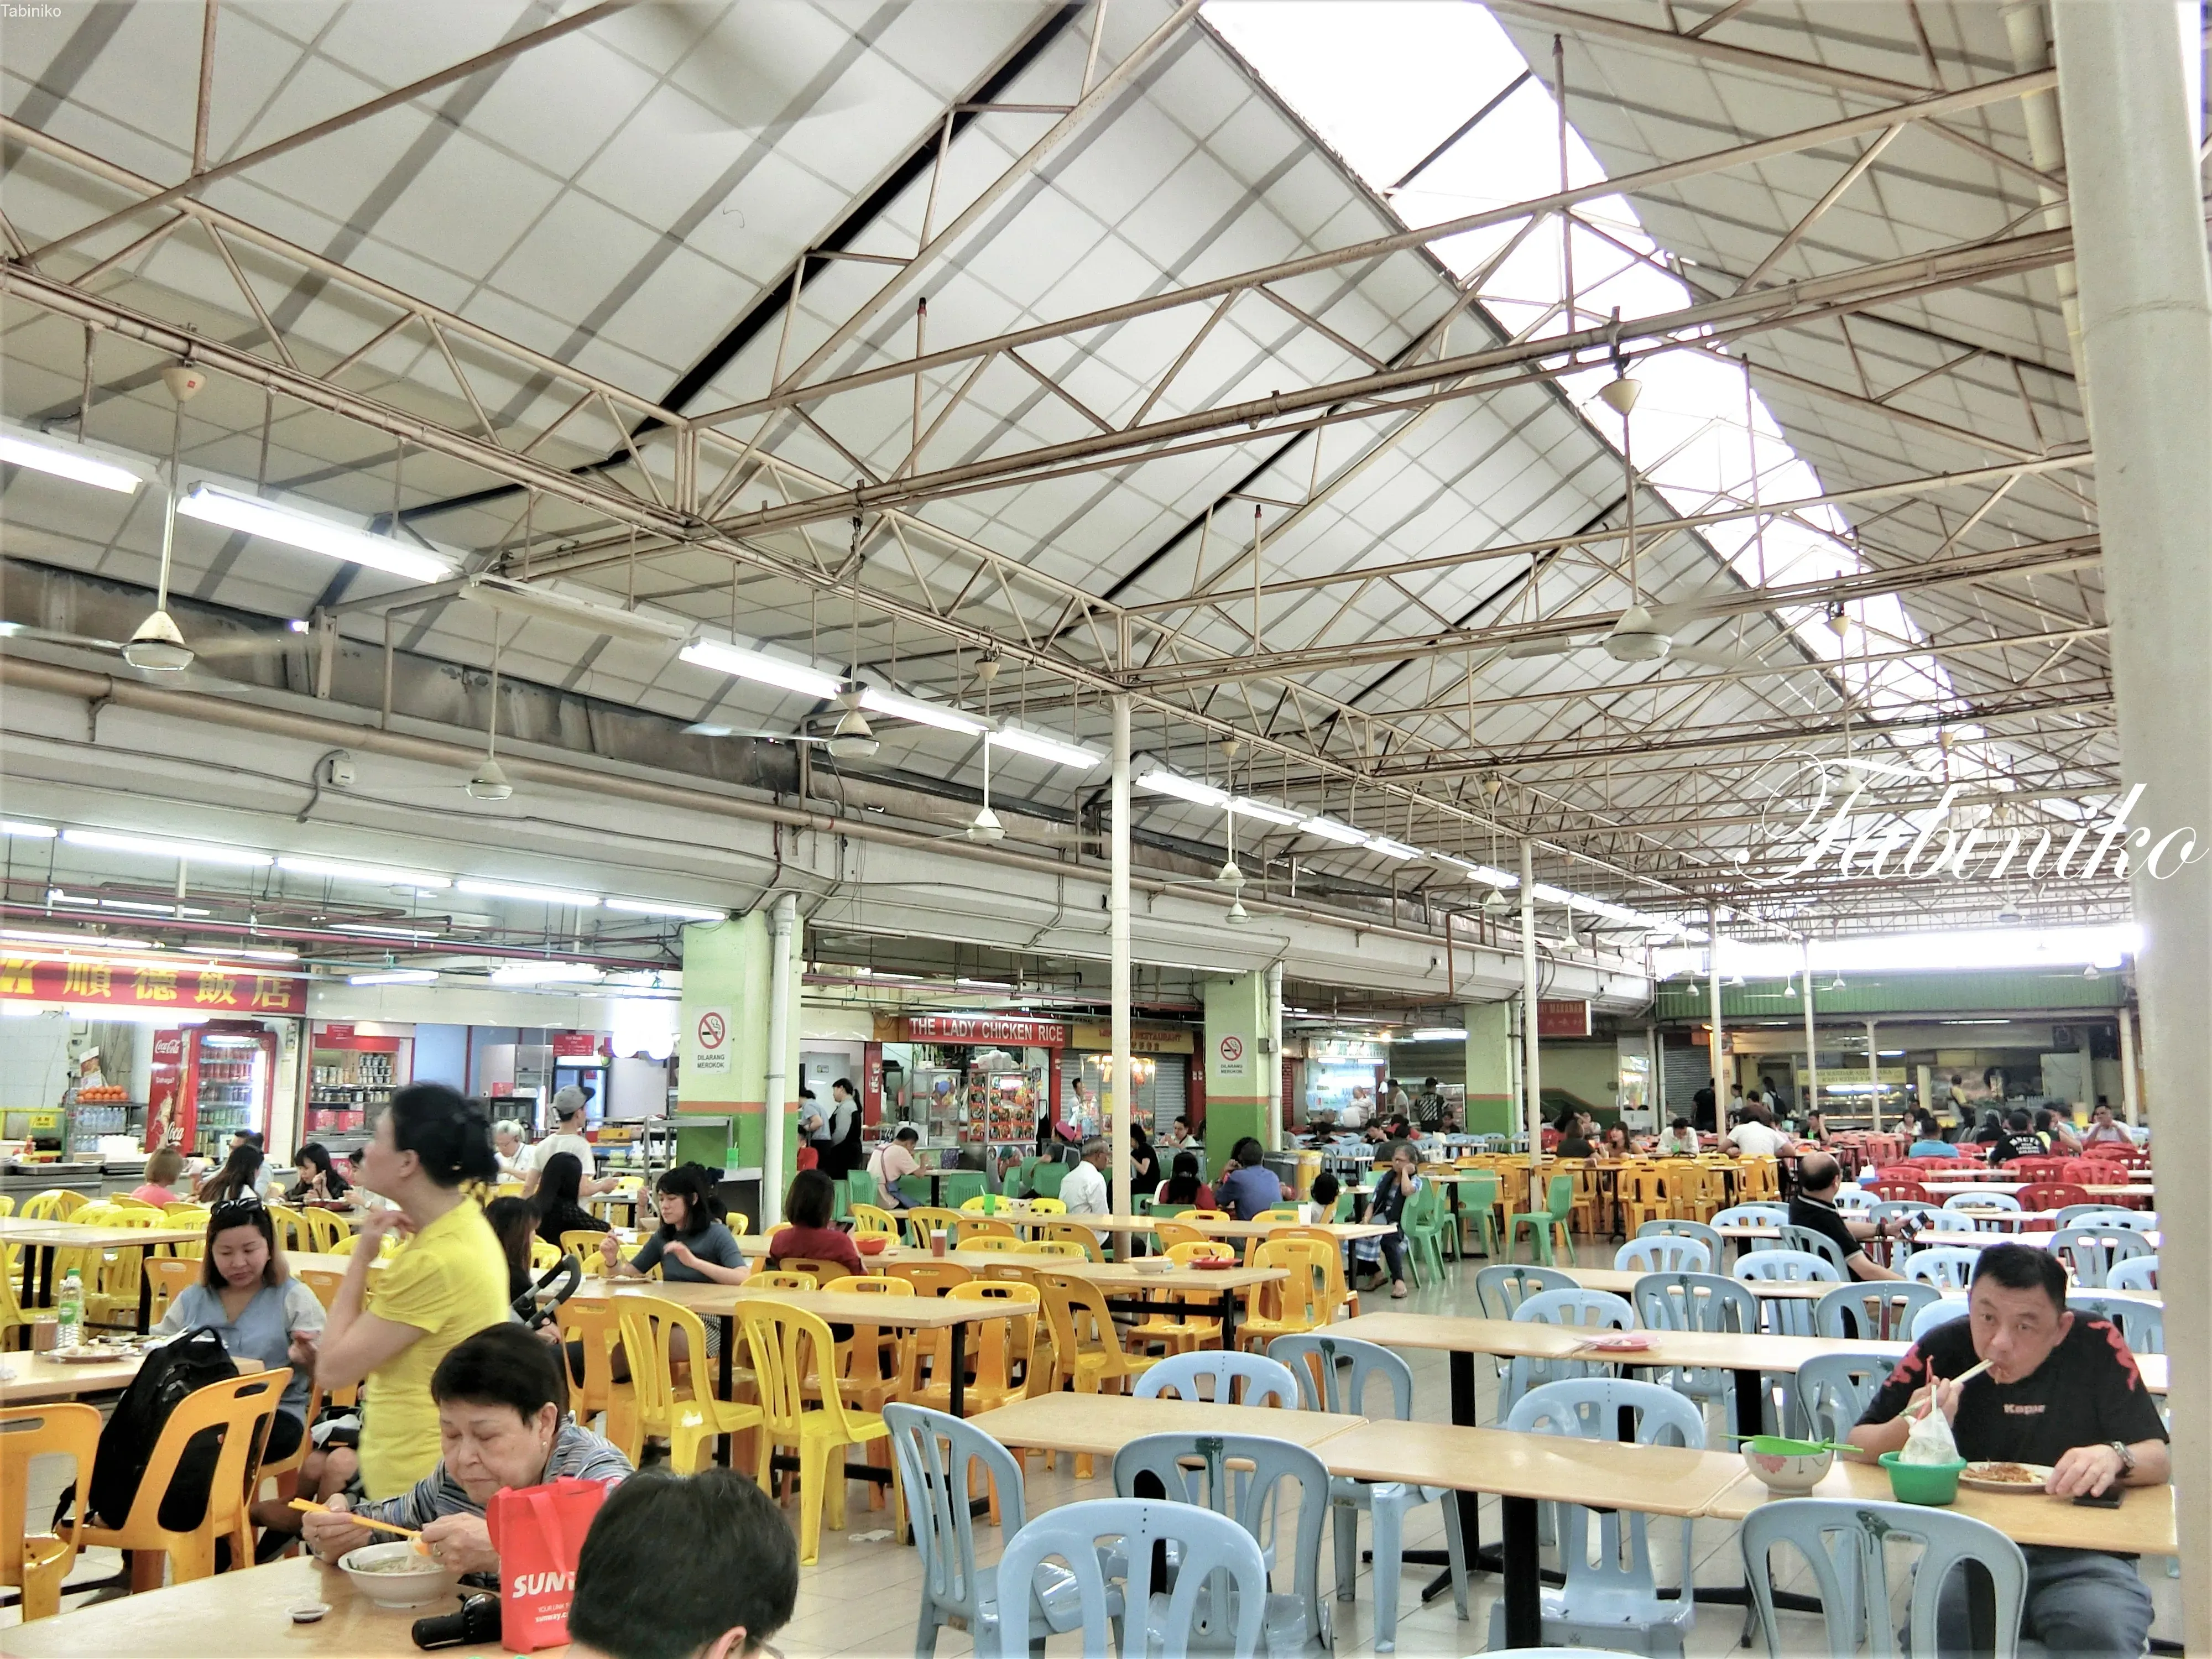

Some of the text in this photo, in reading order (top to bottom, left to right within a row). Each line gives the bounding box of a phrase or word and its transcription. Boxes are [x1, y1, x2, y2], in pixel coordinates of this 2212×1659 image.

[62, 963, 294, 1008] 順德飯店
[911, 1018, 1063, 1042] THE LADY CHICKEN RICE
